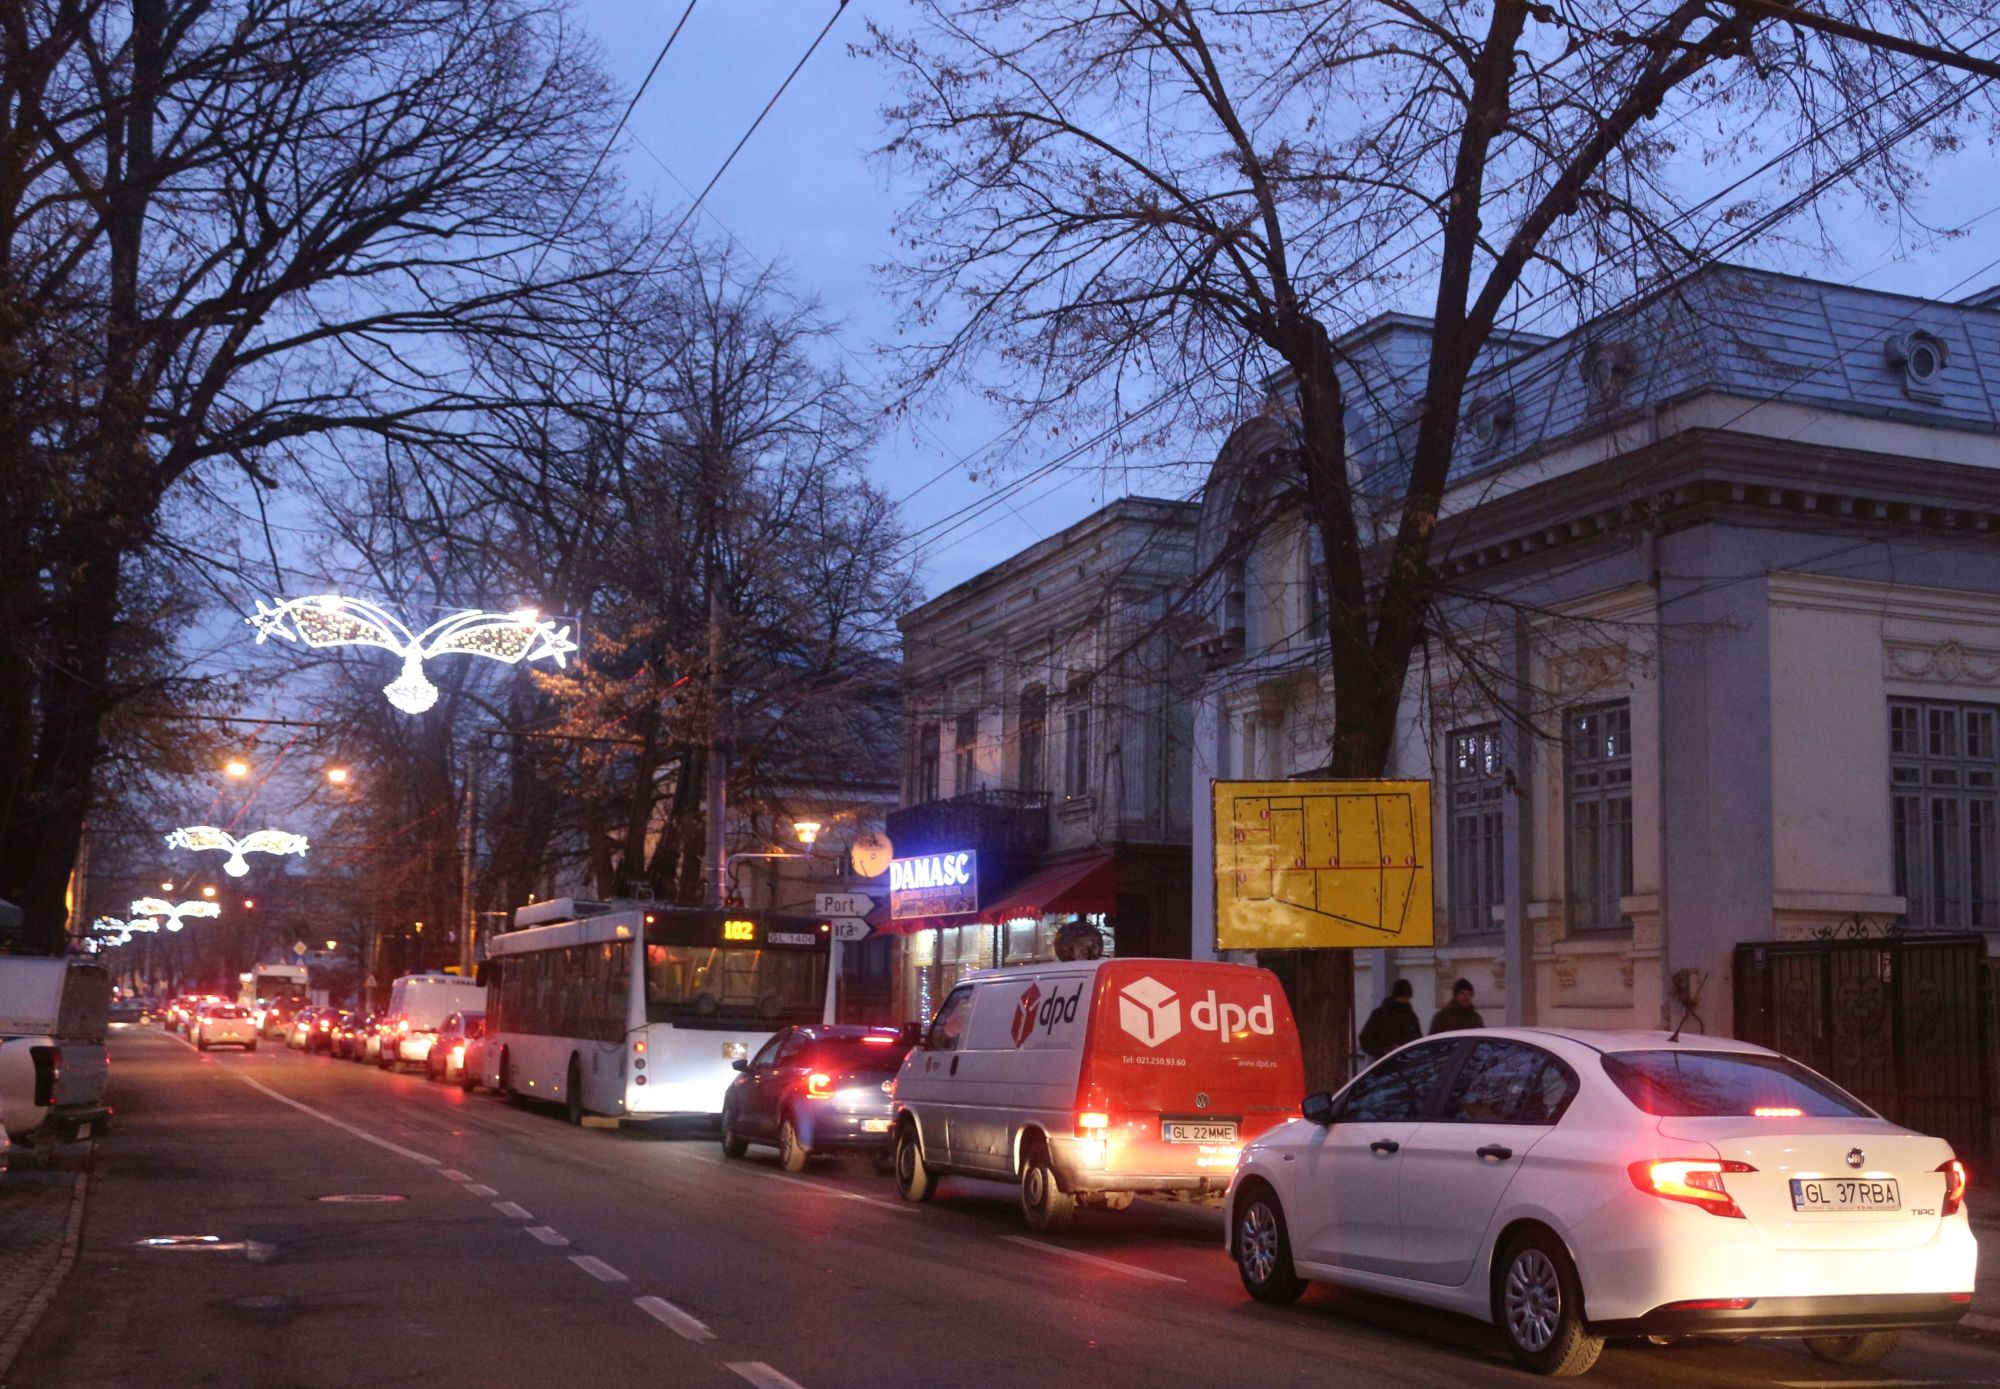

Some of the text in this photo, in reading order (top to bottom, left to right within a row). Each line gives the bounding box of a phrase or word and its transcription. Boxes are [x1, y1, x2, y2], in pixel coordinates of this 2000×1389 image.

[889, 853, 970, 891] DAMASC
[824, 896, 854, 912] Port
[724, 920, 753, 940] 102
[1039, 982, 1083, 1035] dpd
[1190, 989, 1274, 1043] dpd
[1122, 1056, 1186, 1066] Tel: 021.250.93.60
[1238, 1060, 1278, 1068] www.dpd.ro
[1173, 1127, 1189, 1139] GL
[1805, 1183, 1831, 1203] GL
